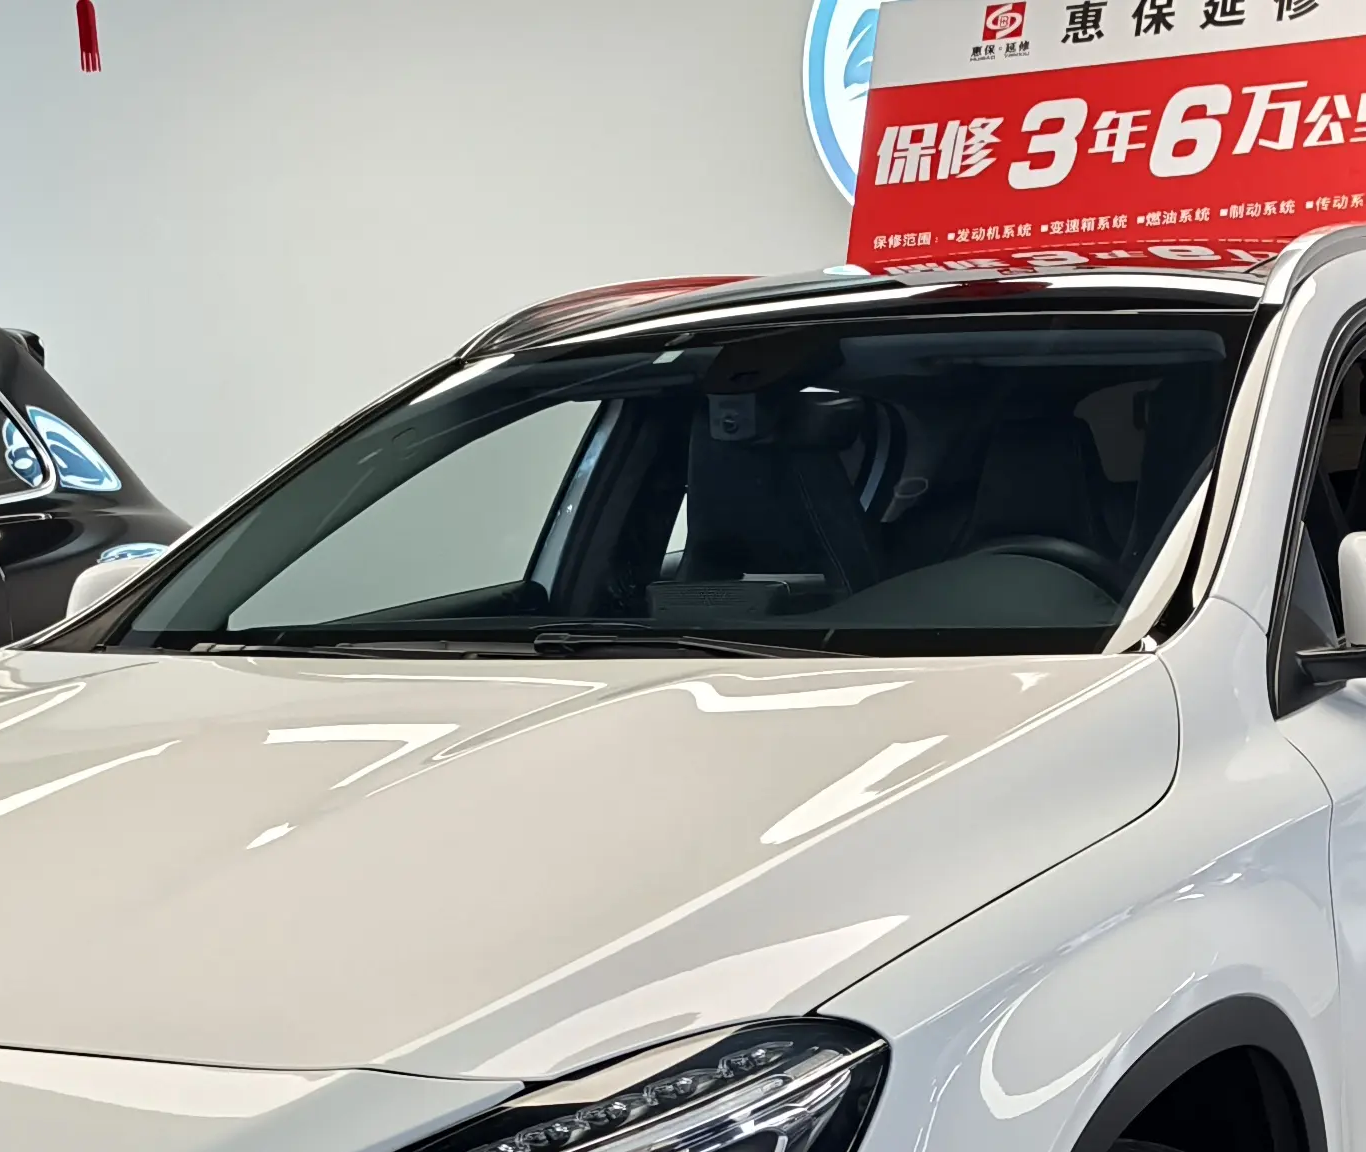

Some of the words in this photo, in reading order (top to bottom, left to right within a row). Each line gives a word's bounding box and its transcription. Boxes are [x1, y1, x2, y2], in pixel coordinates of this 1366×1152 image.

[955, 223, 1033, 243] 发动机系统
[1048, 214, 1128, 235] 变速箱系统
[1145, 206, 1211, 227] 燃油系统
[1229, 199, 1296, 219] 制动系统
